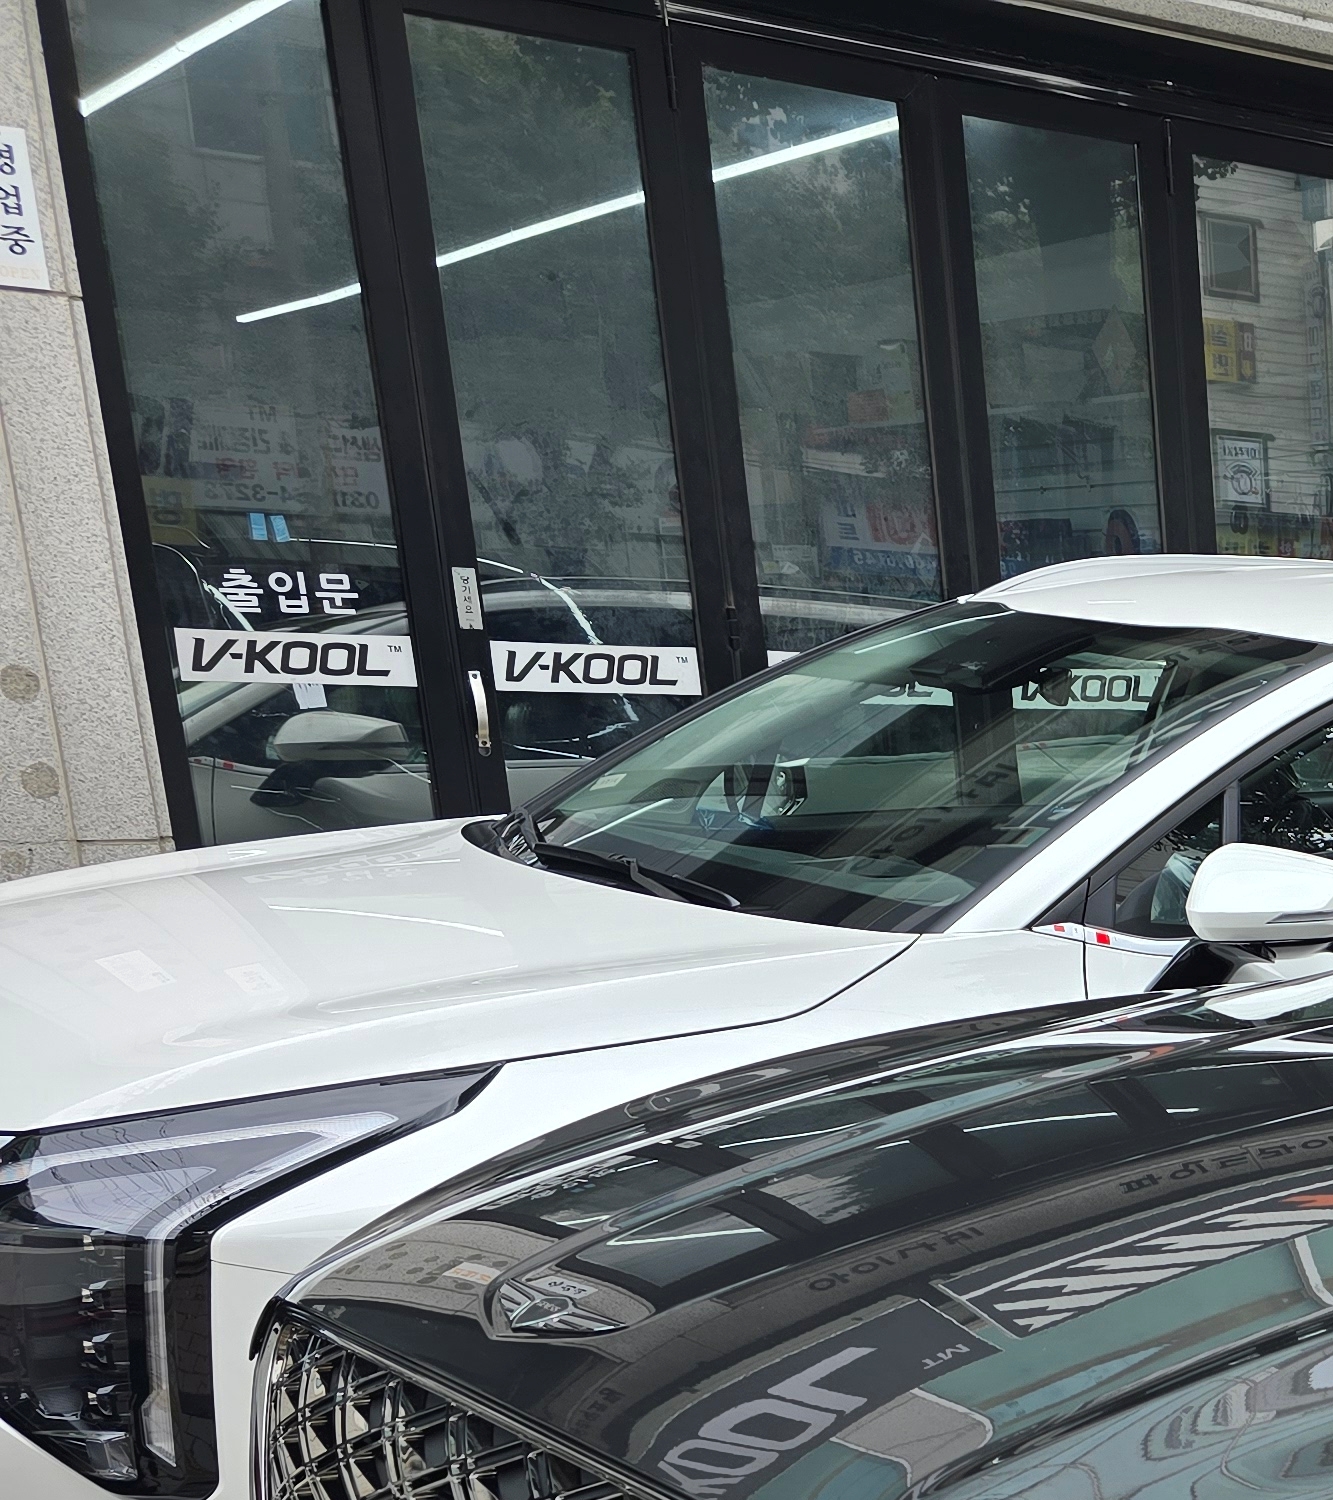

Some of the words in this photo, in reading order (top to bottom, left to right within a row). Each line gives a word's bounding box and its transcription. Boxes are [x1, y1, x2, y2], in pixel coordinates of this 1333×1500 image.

[219, 568, 359, 615] 출입문
[191, 636, 391, 678] V-KOOL
[387, 644, 403, 654] TM
[505, 650, 679, 687] V-KOOL
[675, 655, 689, 664] TM
[1021, 675, 1152, 702] VKOOL
